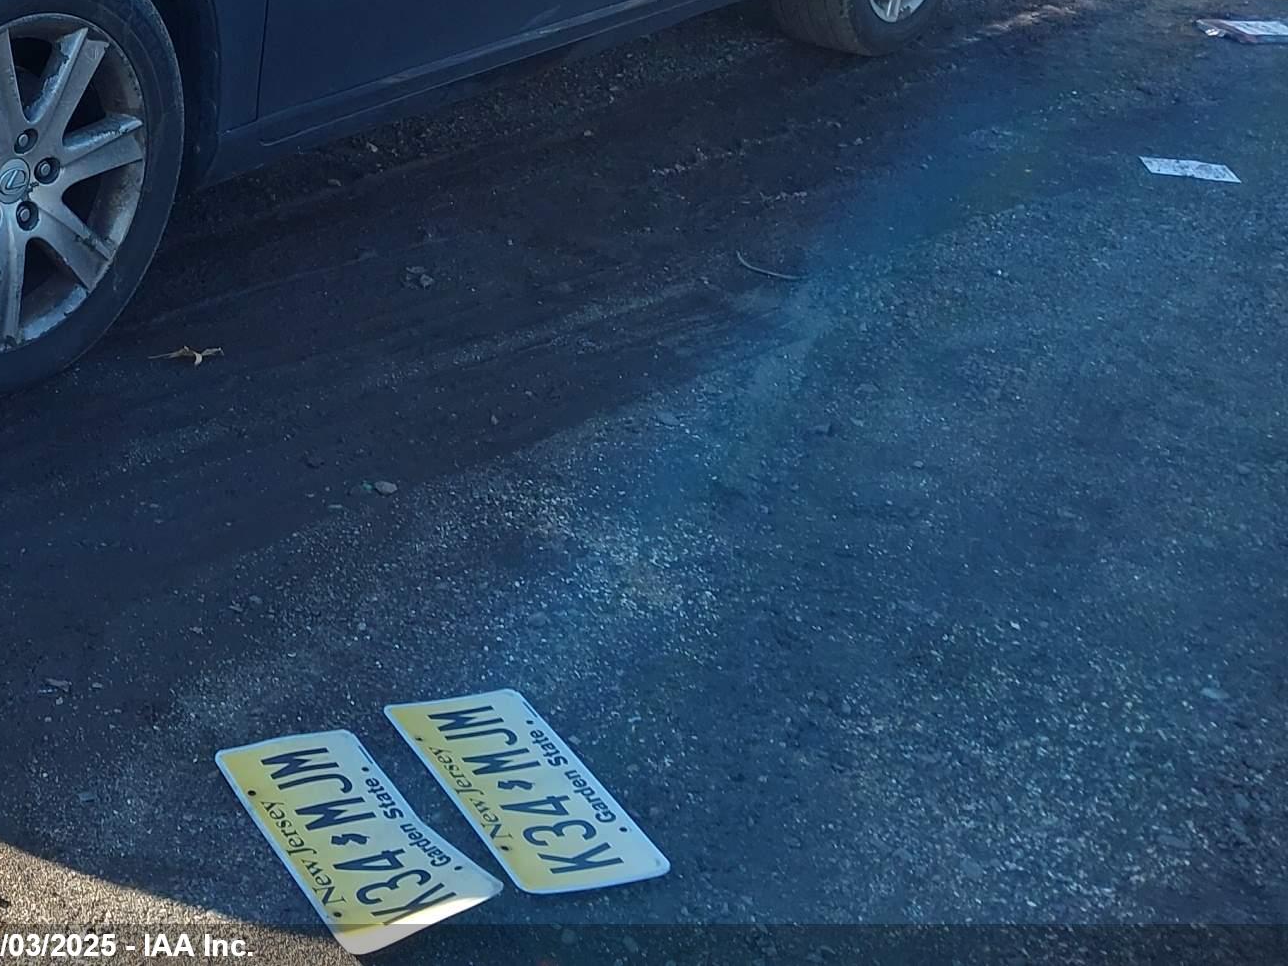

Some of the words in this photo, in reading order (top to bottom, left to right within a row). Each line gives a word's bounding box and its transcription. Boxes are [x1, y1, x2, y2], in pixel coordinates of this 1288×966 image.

[427, 705, 541, 776] MJM
[529, 729, 569, 768] State
[260, 747, 377, 832] MJM
[364, 776, 404, 820] State
[428, 746, 485, 797] Jersey
[563, 769, 617, 825] Garden
[260, 800, 318, 858] Jersey
[399, 822, 452, 868] Garden
[469, 797, 514, 842] New
[499, 794, 625, 875] K34
[301, 859, 348, 907] New
[332, 847, 457, 926] K34
